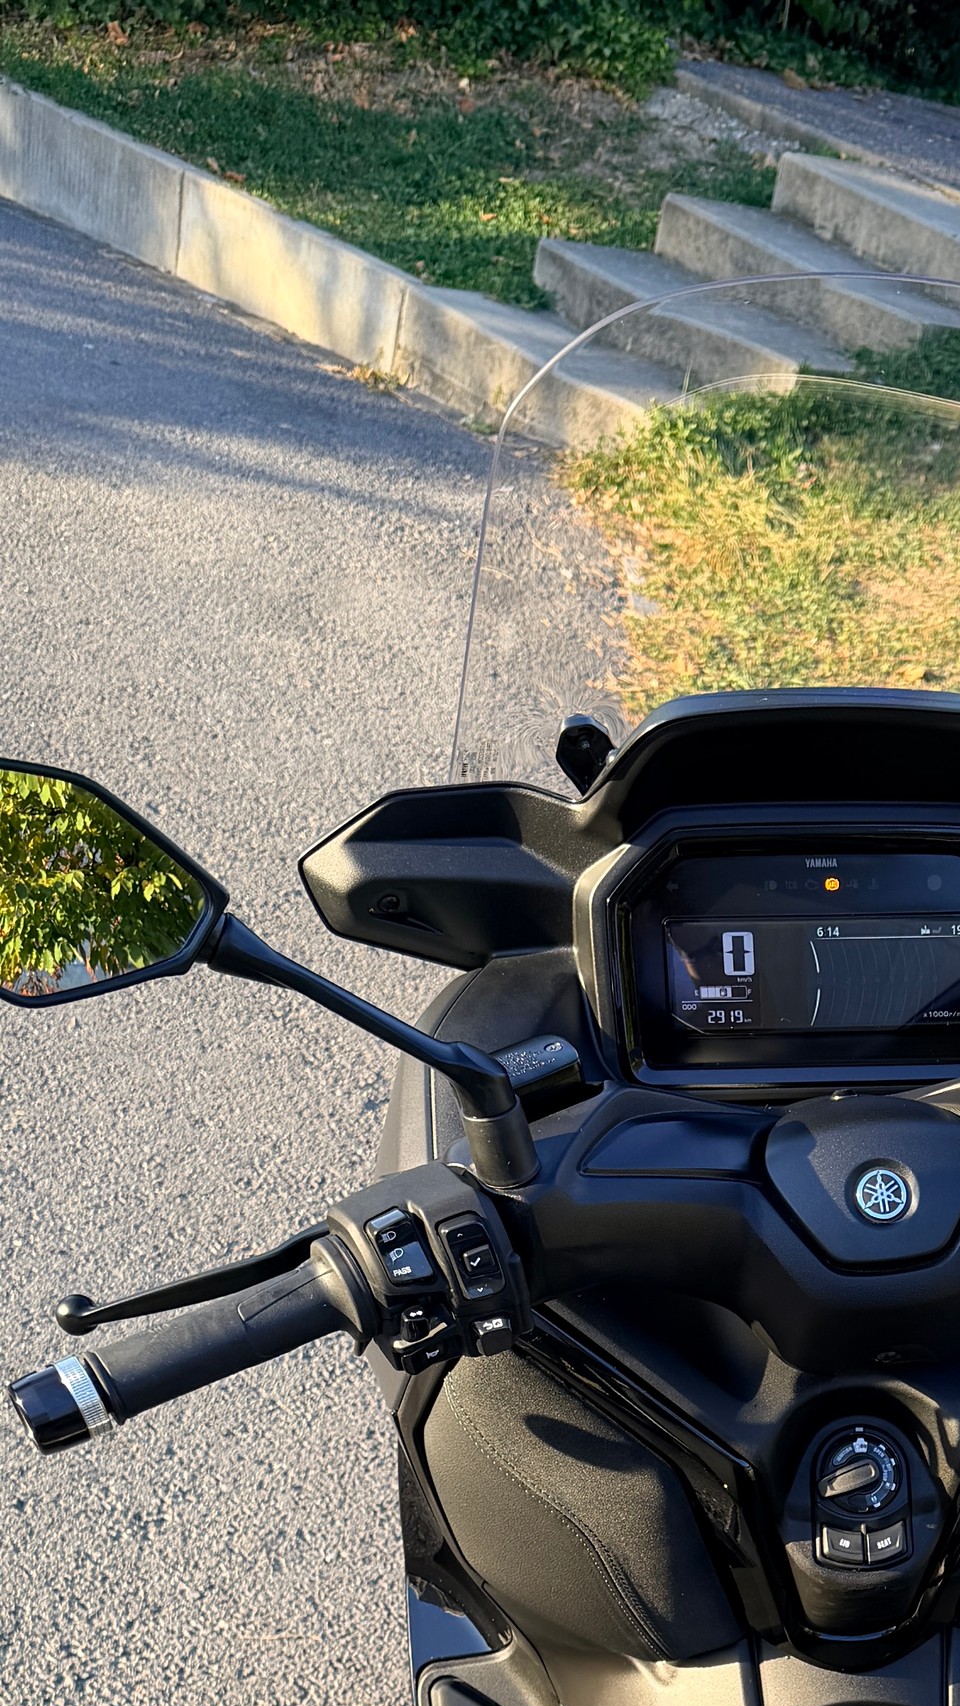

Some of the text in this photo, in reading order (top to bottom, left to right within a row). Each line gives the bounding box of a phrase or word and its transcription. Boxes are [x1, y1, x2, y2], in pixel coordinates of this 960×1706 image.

[805, 858, 838, 868] YAMAHA
[708, 1010, 744, 1024] 2919
[392, 1266, 412, 1277] PASS
